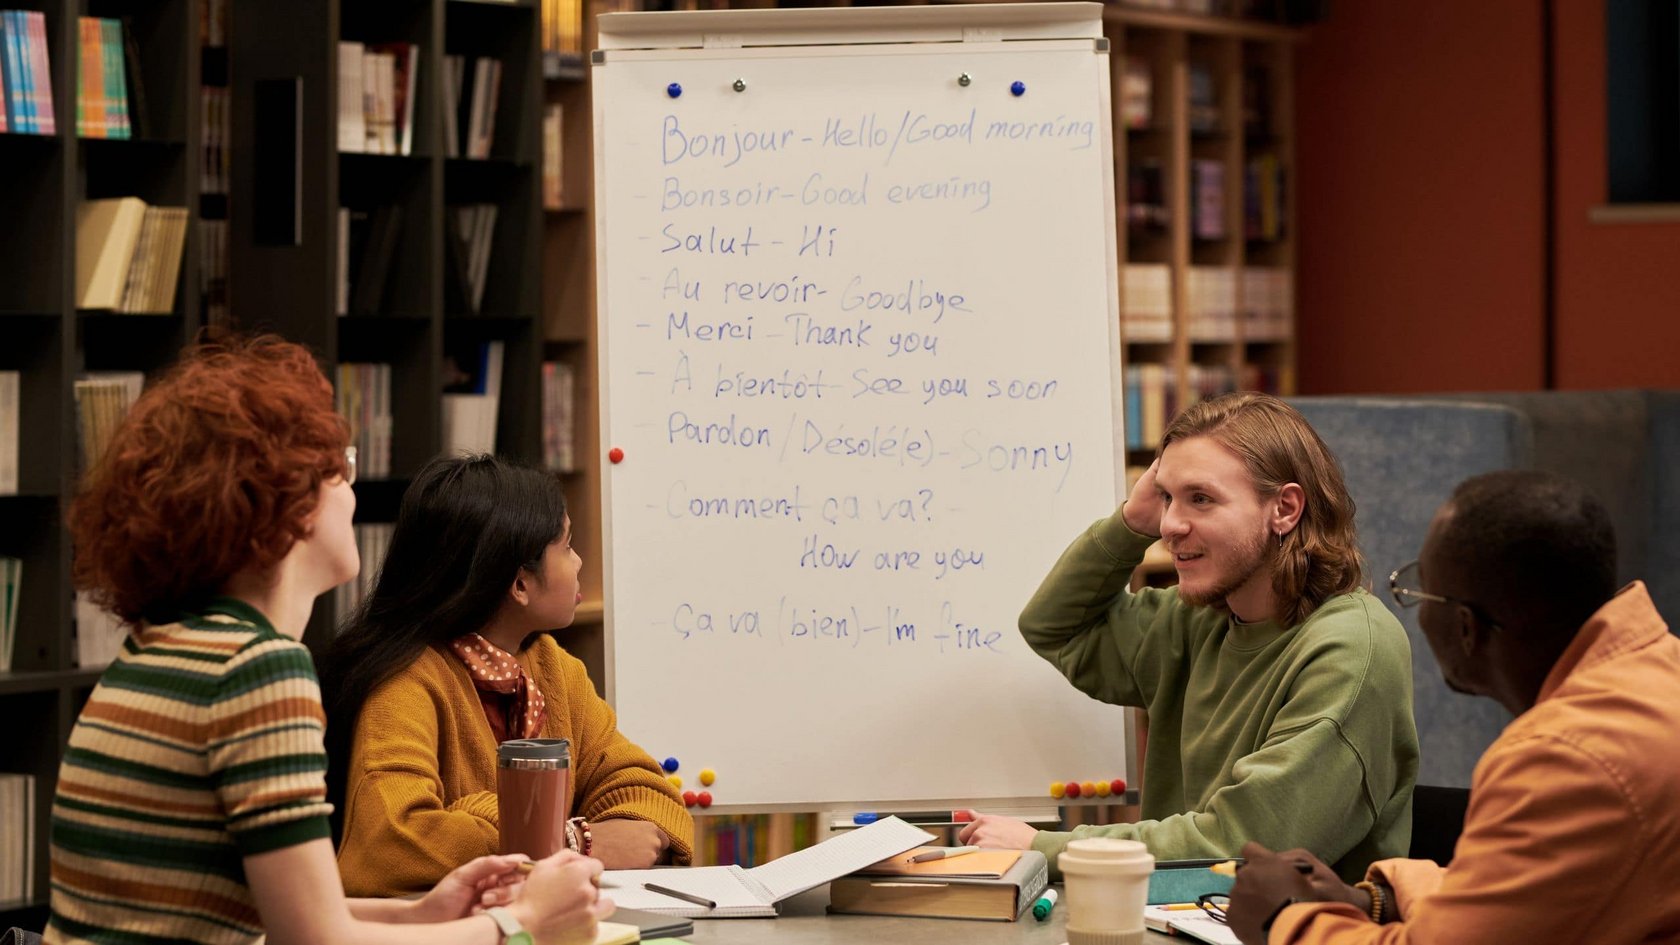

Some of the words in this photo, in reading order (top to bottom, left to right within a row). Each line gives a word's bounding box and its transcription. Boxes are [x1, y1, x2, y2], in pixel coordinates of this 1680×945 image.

[985, 114, 1095, 151] morning
[887, 177, 991, 214] evening
[661, 223, 760, 256] Salut
[798, 225, 837, 257] Hi
[662, 267, 700, 301] Au
[840, 275, 973, 324] Goodbye
[667, 312, 754, 341] Merci
[785, 312, 870, 348] Thank
[887, 331, 937, 357] you
[852, 368, 910, 399] See
[923, 377, 967, 405] you
[987, 377, 1058, 400] soon
[667, 411, 771, 446] Pardon
[666, 479, 812, 523] Comment
[879, 489, 934, 522] va?
[800, 534, 860, 570] How
[874, 549, 920, 571] are
[935, 550, 984, 579] you
[673, 602, 713, 639] Ça
[729, 609, 761, 636] va
[933, 601, 1003, 654] fine
